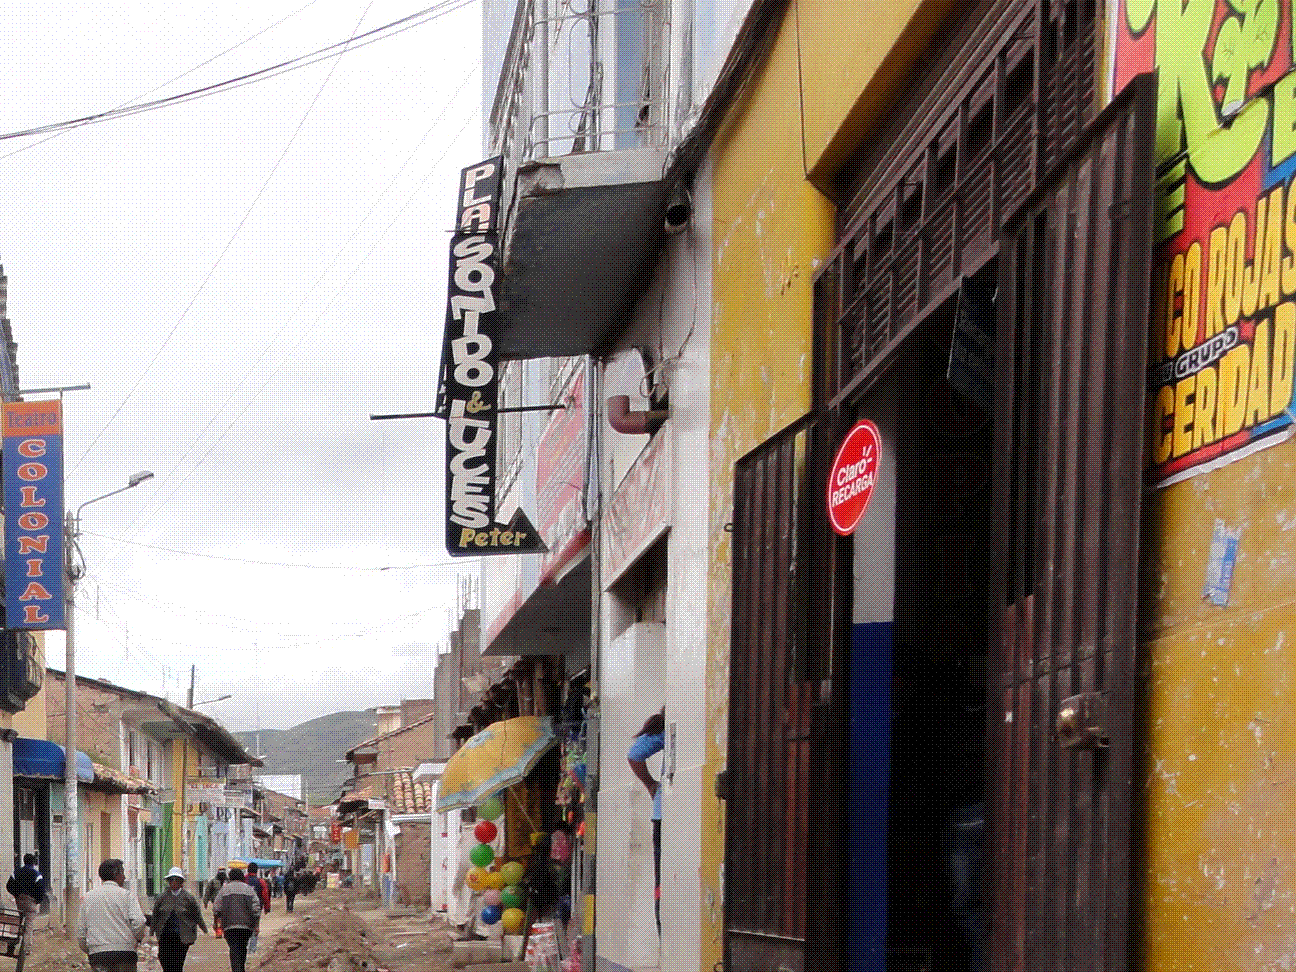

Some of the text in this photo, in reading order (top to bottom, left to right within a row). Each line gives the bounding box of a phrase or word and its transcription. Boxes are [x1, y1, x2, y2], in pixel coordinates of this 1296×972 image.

[450, 235, 496, 387] SONIDO
[1175, 327, 1238, 378] GRUPO
[1153, 302, 1296, 465] CERIDAD
[6, 411, 57, 429] Teatro
[449, 390, 492, 529] & LUCES
[837, 457, 868, 487] Claro
[832, 471, 874, 507] RECARGA
[17, 439, 53, 624] COLONIAL
[459, 528, 526, 547] Peter
